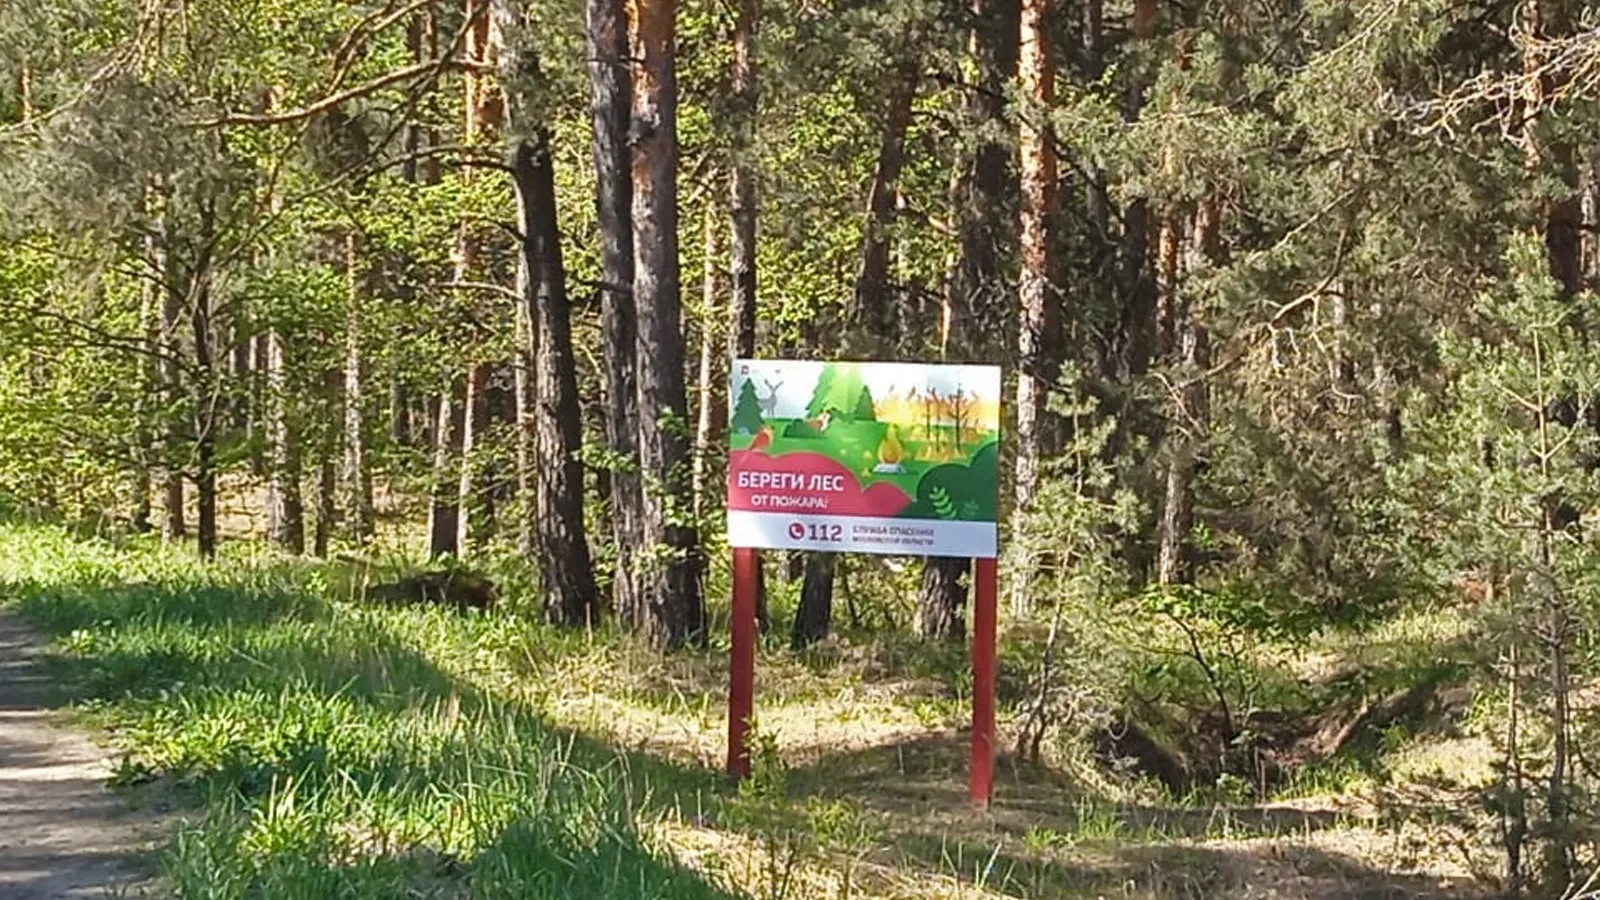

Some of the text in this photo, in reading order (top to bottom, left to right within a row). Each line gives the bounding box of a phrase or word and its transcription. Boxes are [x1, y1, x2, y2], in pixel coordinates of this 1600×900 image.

[738, 471, 844, 491] БЕРЕГИ ЛЕС
[751, 494, 768, 506] ОТ
[808, 524, 842, 542] 112
